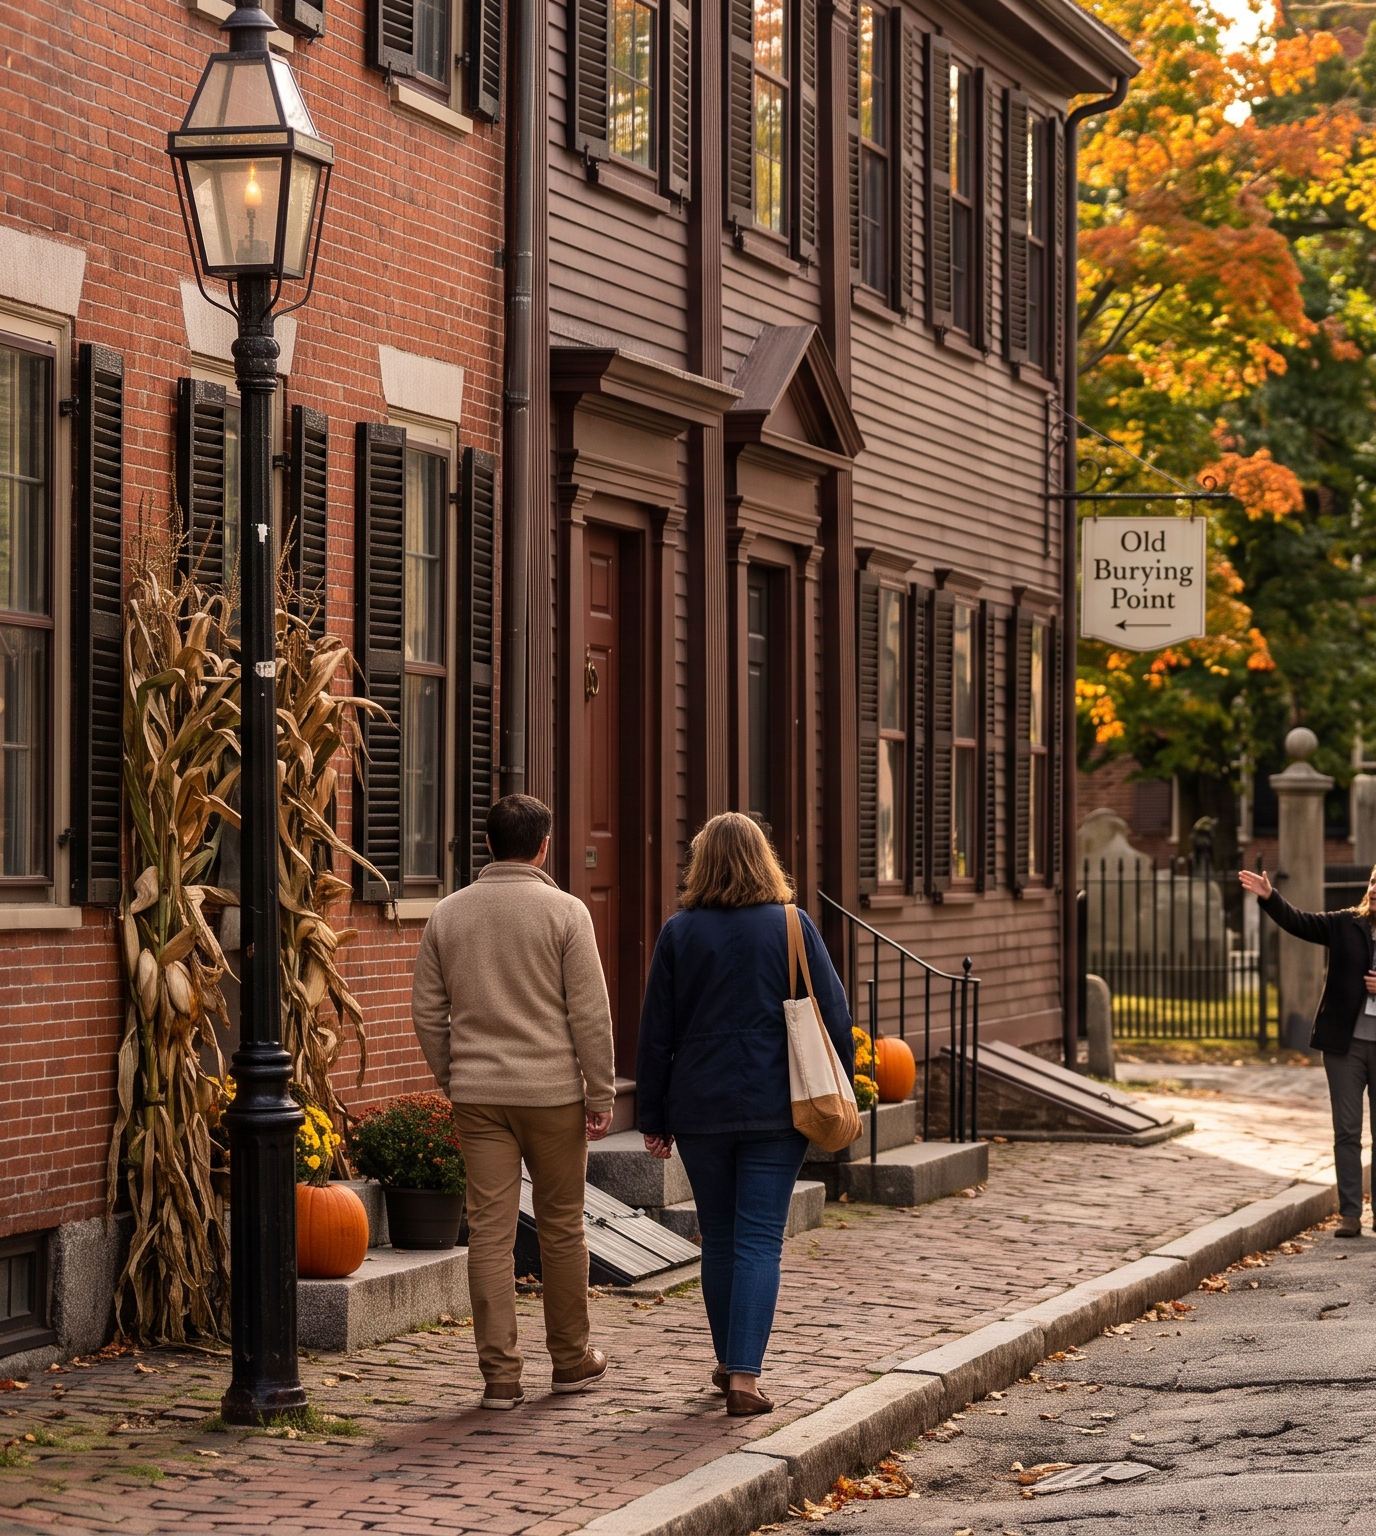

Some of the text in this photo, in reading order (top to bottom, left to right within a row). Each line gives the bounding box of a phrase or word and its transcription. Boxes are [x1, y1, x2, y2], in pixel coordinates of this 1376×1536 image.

[1120, 530, 1166, 553] Old
[1093, 558, 1194, 588] Burying
[1111, 587, 1176, 609] Point
